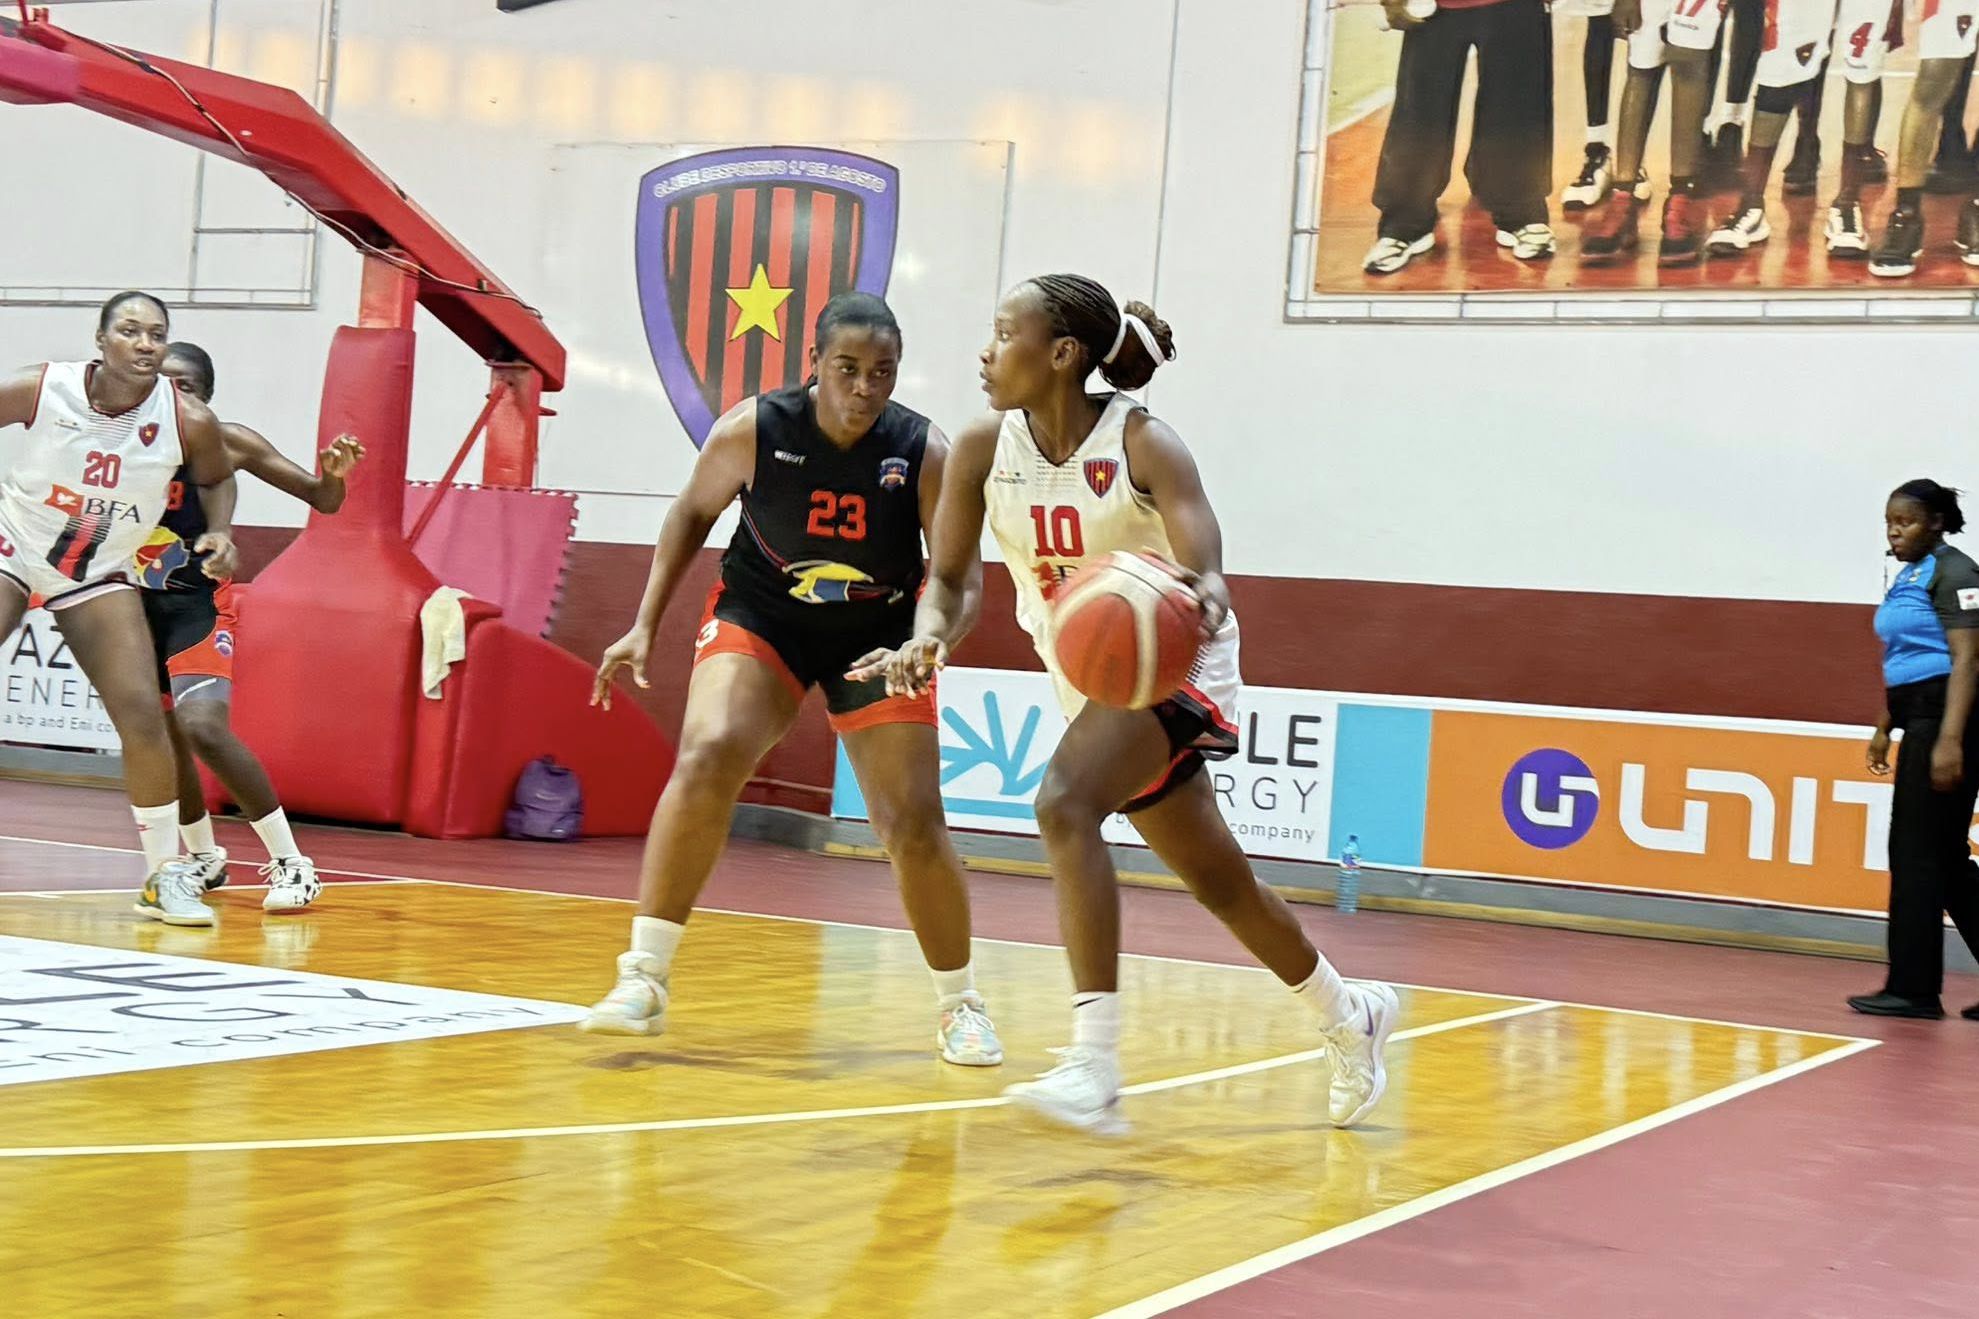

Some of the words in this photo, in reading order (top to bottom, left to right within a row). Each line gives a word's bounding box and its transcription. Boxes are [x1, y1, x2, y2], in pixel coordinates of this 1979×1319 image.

[82, 450, 121, 489] 20
[84, 498, 141, 524] BFA
[807, 489, 867, 541] 23
[1030, 505, 1085, 557] 10
[10, 623, 73, 669] AZ
[7, 675, 104, 709] ENER
[40, 716, 65, 729] and
[96, 722, 113, 733] co
[1207, 711, 1322, 769] LE
[1214, 773, 1318, 814] RGY
[1230, 821, 1317, 844] company
[1619, 762, 1896, 872] UNIT
[170, 1006, 545, 1047] company
